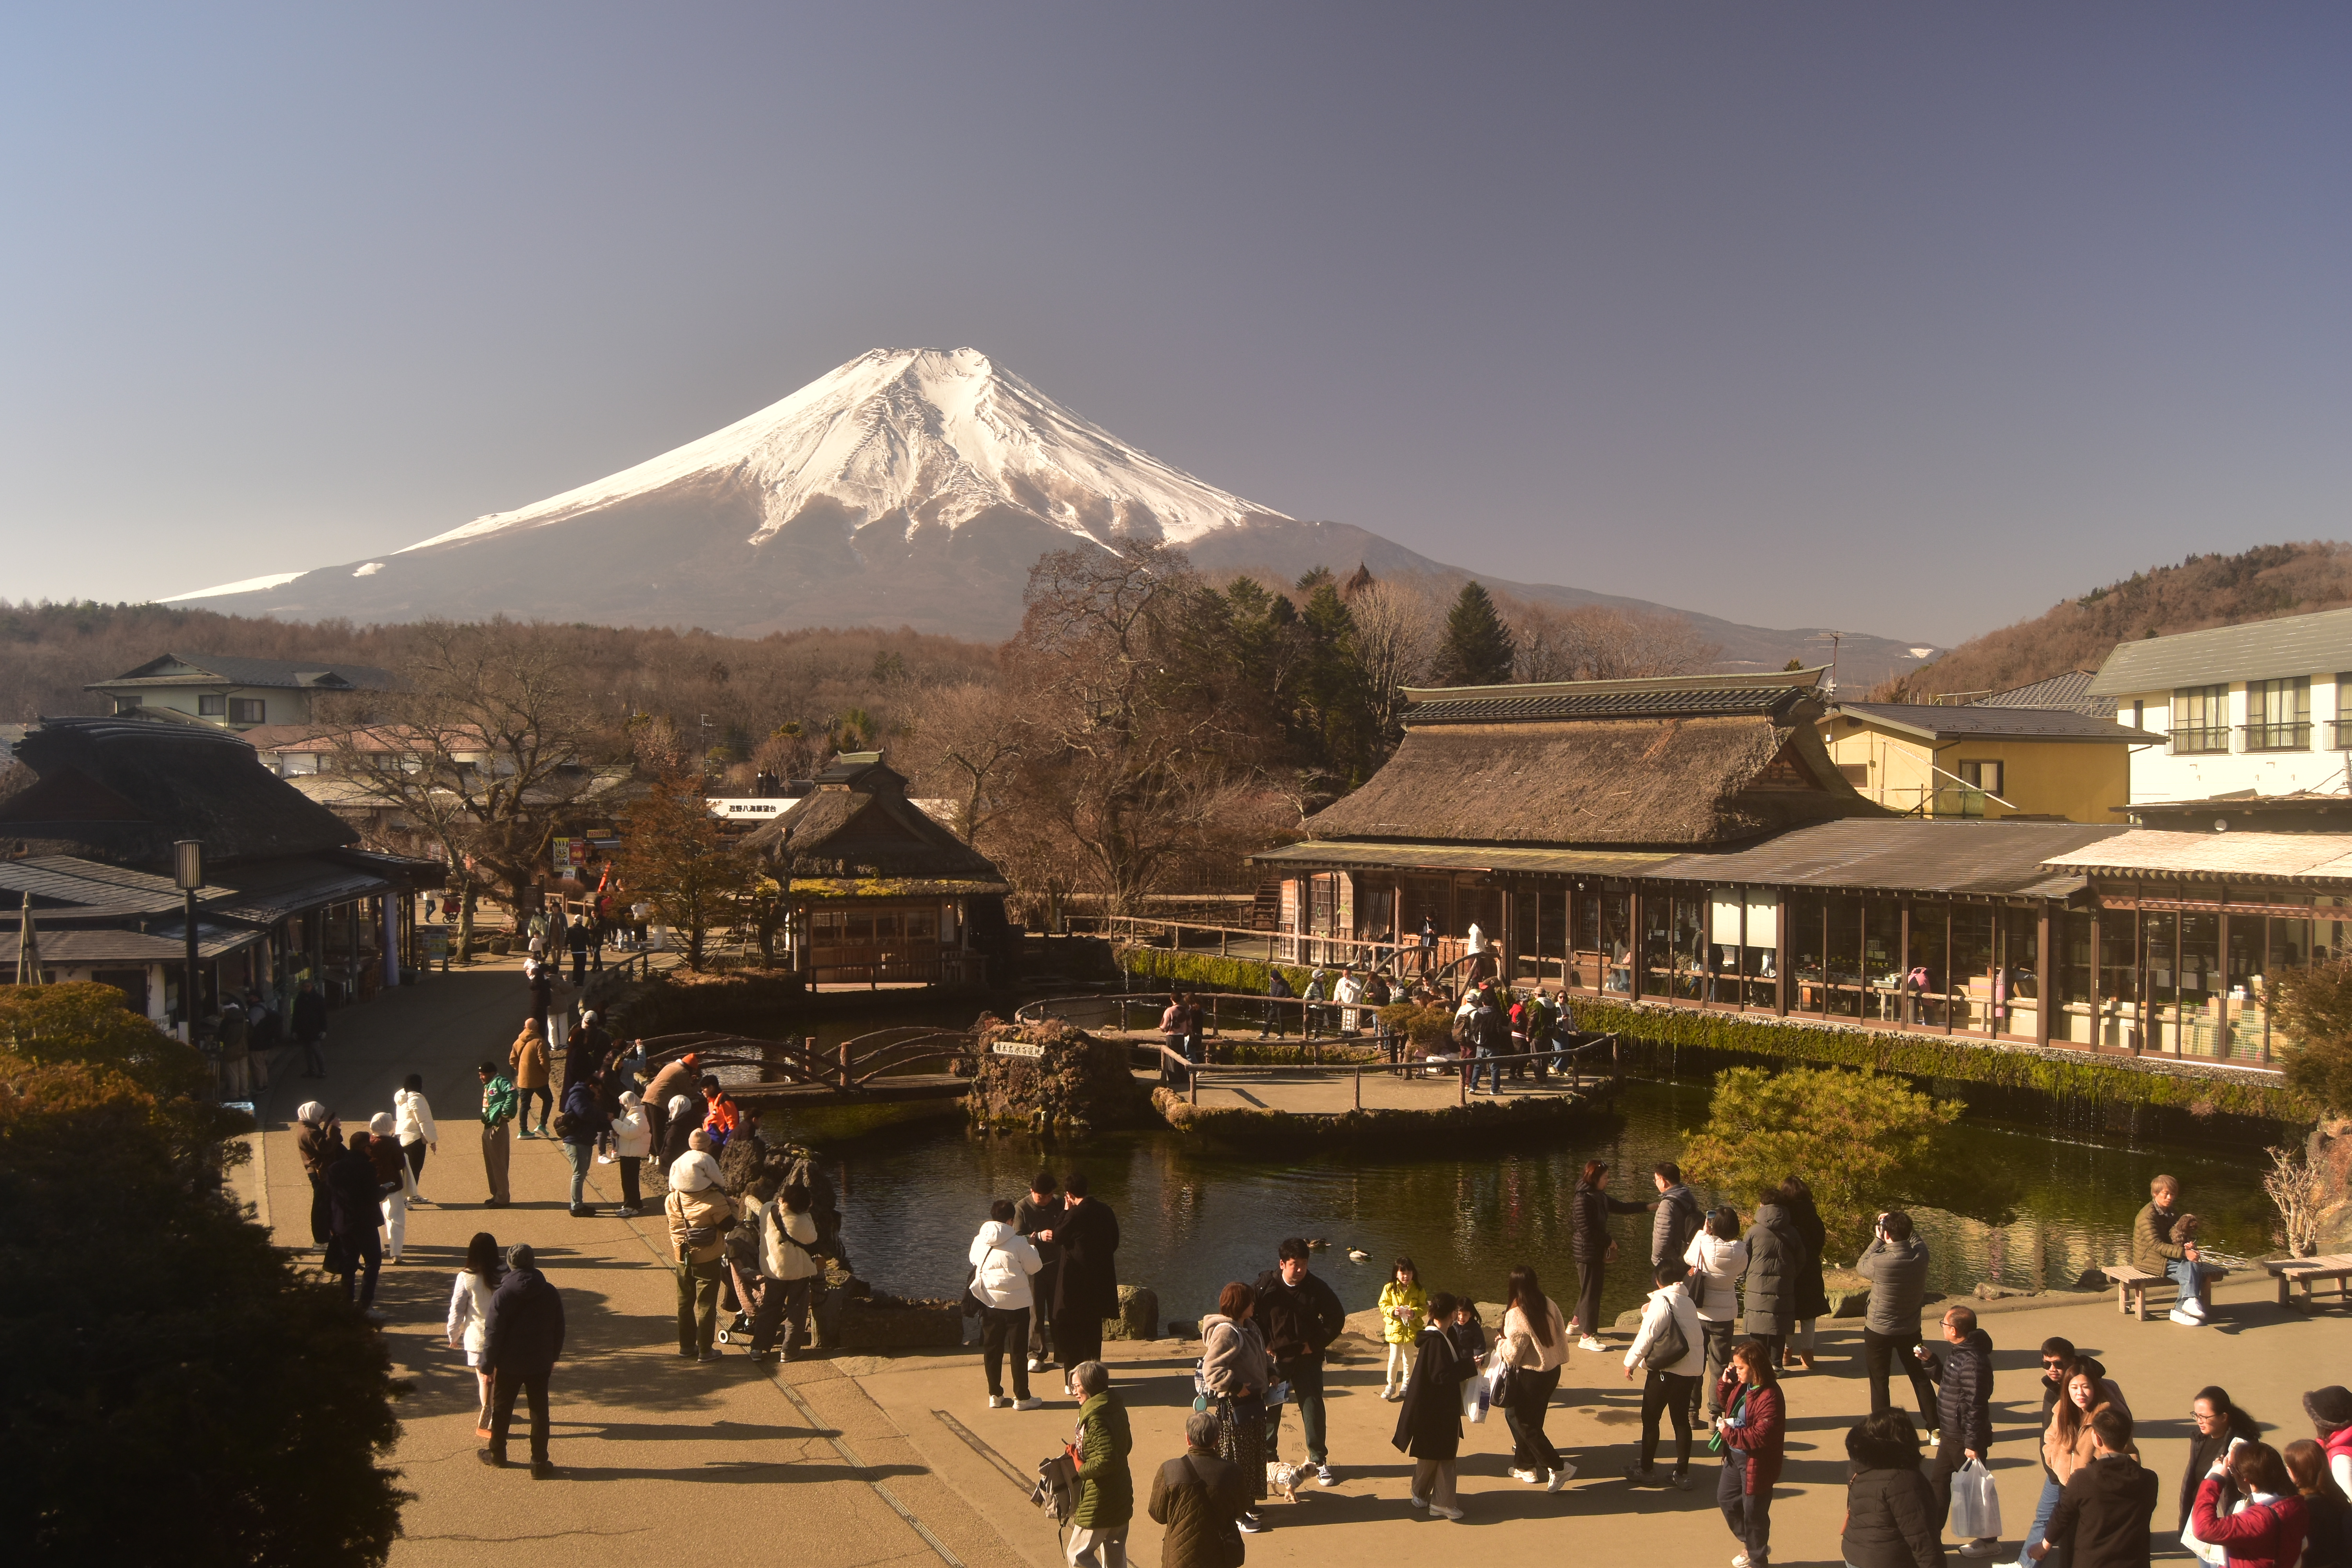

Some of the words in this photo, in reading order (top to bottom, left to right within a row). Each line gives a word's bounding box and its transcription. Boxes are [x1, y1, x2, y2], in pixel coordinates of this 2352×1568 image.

[996, 1044, 1041, 1055] 日本名水百選地
